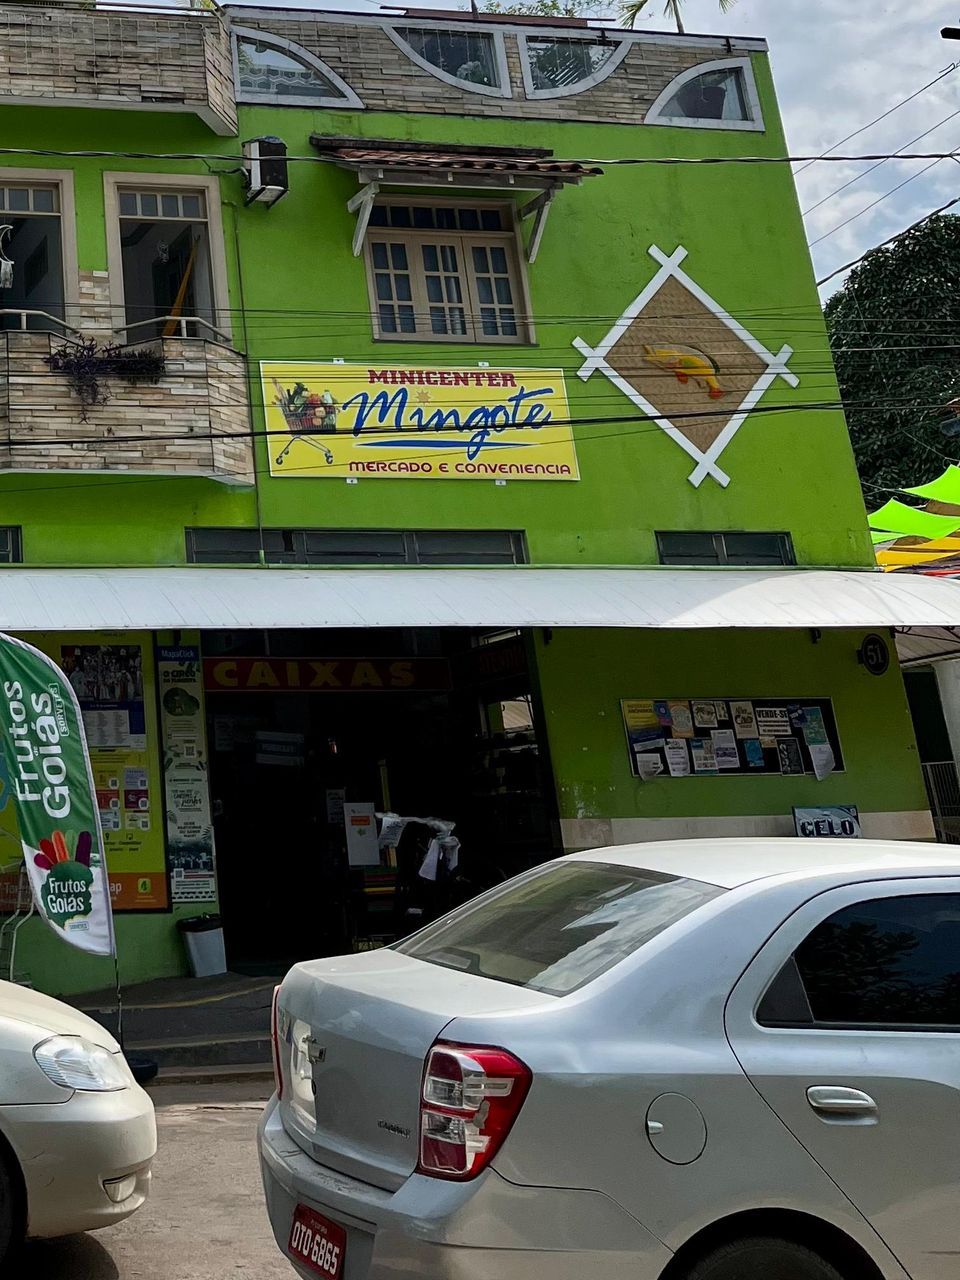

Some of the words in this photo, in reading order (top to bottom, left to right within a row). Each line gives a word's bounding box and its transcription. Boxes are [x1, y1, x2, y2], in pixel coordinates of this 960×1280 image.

[368, 369, 518, 388] MINICENTER
[342, 385, 554, 461] Mingote
[348, 460, 433, 474] MERCADO
[438, 462, 449, 474] E
[454, 462, 572, 476] CONVENIENCIA
[866, 644, 884, 666] 51
[212, 661, 417, 688] CAIXAS
[3, 680, 42, 801] Frutos
[30, 692, 72, 818] Goiás
[800, 817, 855, 837] GELO
[48, 877, 86, 894] Frutos
[47, 894, 85, 914] Goiás
